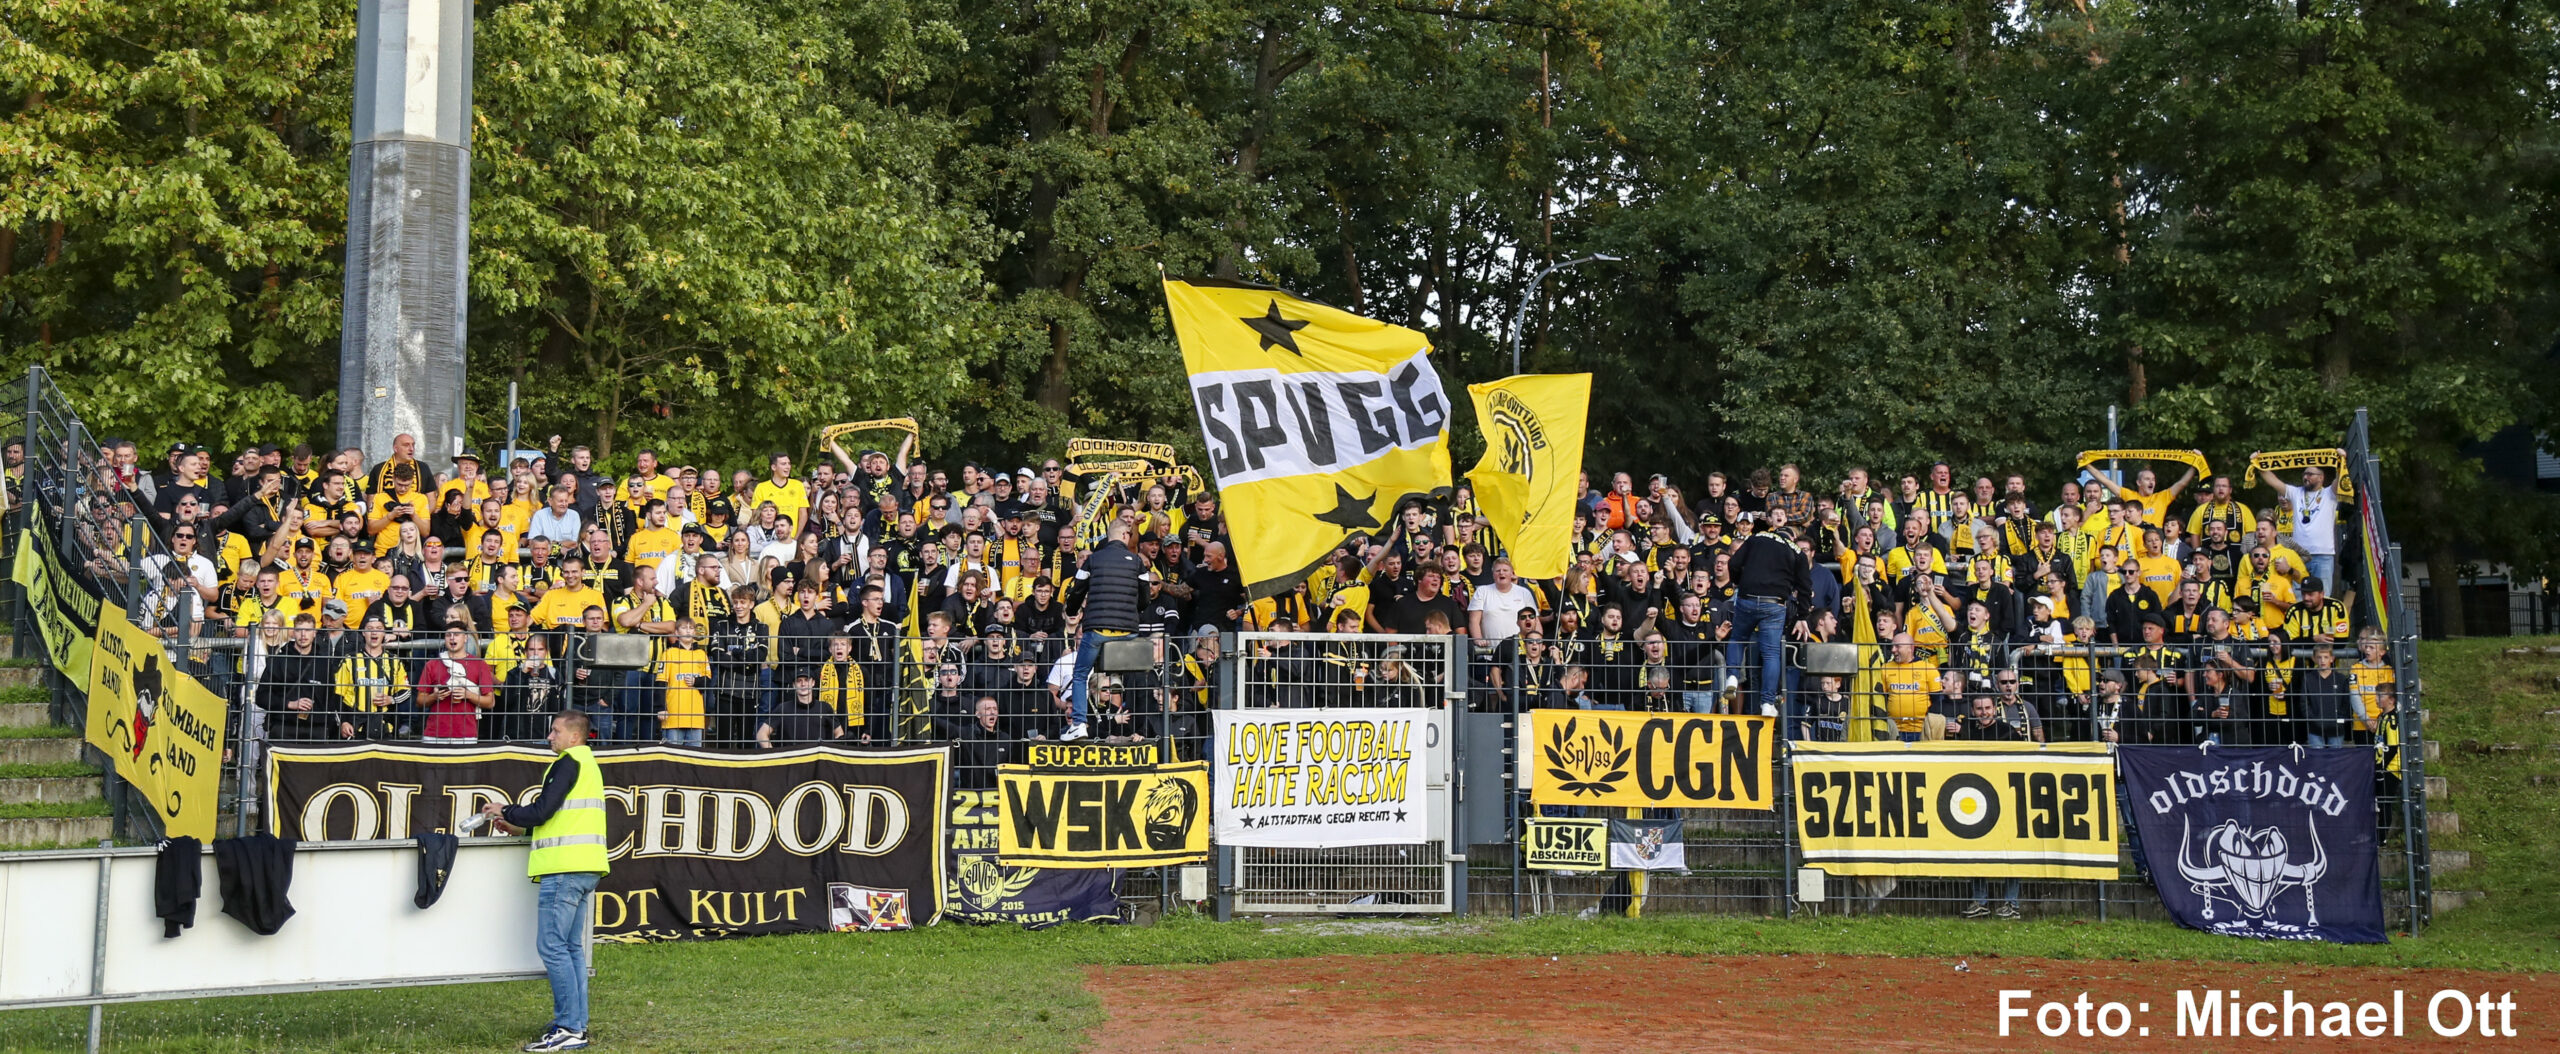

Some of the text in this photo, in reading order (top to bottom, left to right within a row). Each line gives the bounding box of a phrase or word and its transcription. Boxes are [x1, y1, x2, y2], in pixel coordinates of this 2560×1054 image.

[639, 550, 667, 560] maxit
[2145, 574, 2173, 582] maxit
[1890, 682, 1919, 691] maxit
[166, 736, 196, 777] LAND
[1034, 745, 1151, 765] SUPCREW
[1228, 721, 1290, 765] LOVE
[1296, 720, 1411, 764] FOOTBALL
[1562, 735, 1611, 776] SpVgg
[1635, 718, 1764, 801] CGN
[1232, 761, 1408, 808] HATE RACISM
[2149, 760, 2349, 817] oldschdöd
[1005, 779, 1142, 851] WSK
[1256, 811, 1390, 829] ALTSTADTFANS GEGEN RECHTS
[1801, 771, 2109, 841] SZENE 1921
[1535, 824, 1595, 850] USK
[1530, 851, 1601, 862] ABSCHAFFEN
[965, 863, 997, 892] SPVGG
[689, 887, 806, 926] KULT
[1001, 901, 1024, 911] 2015
